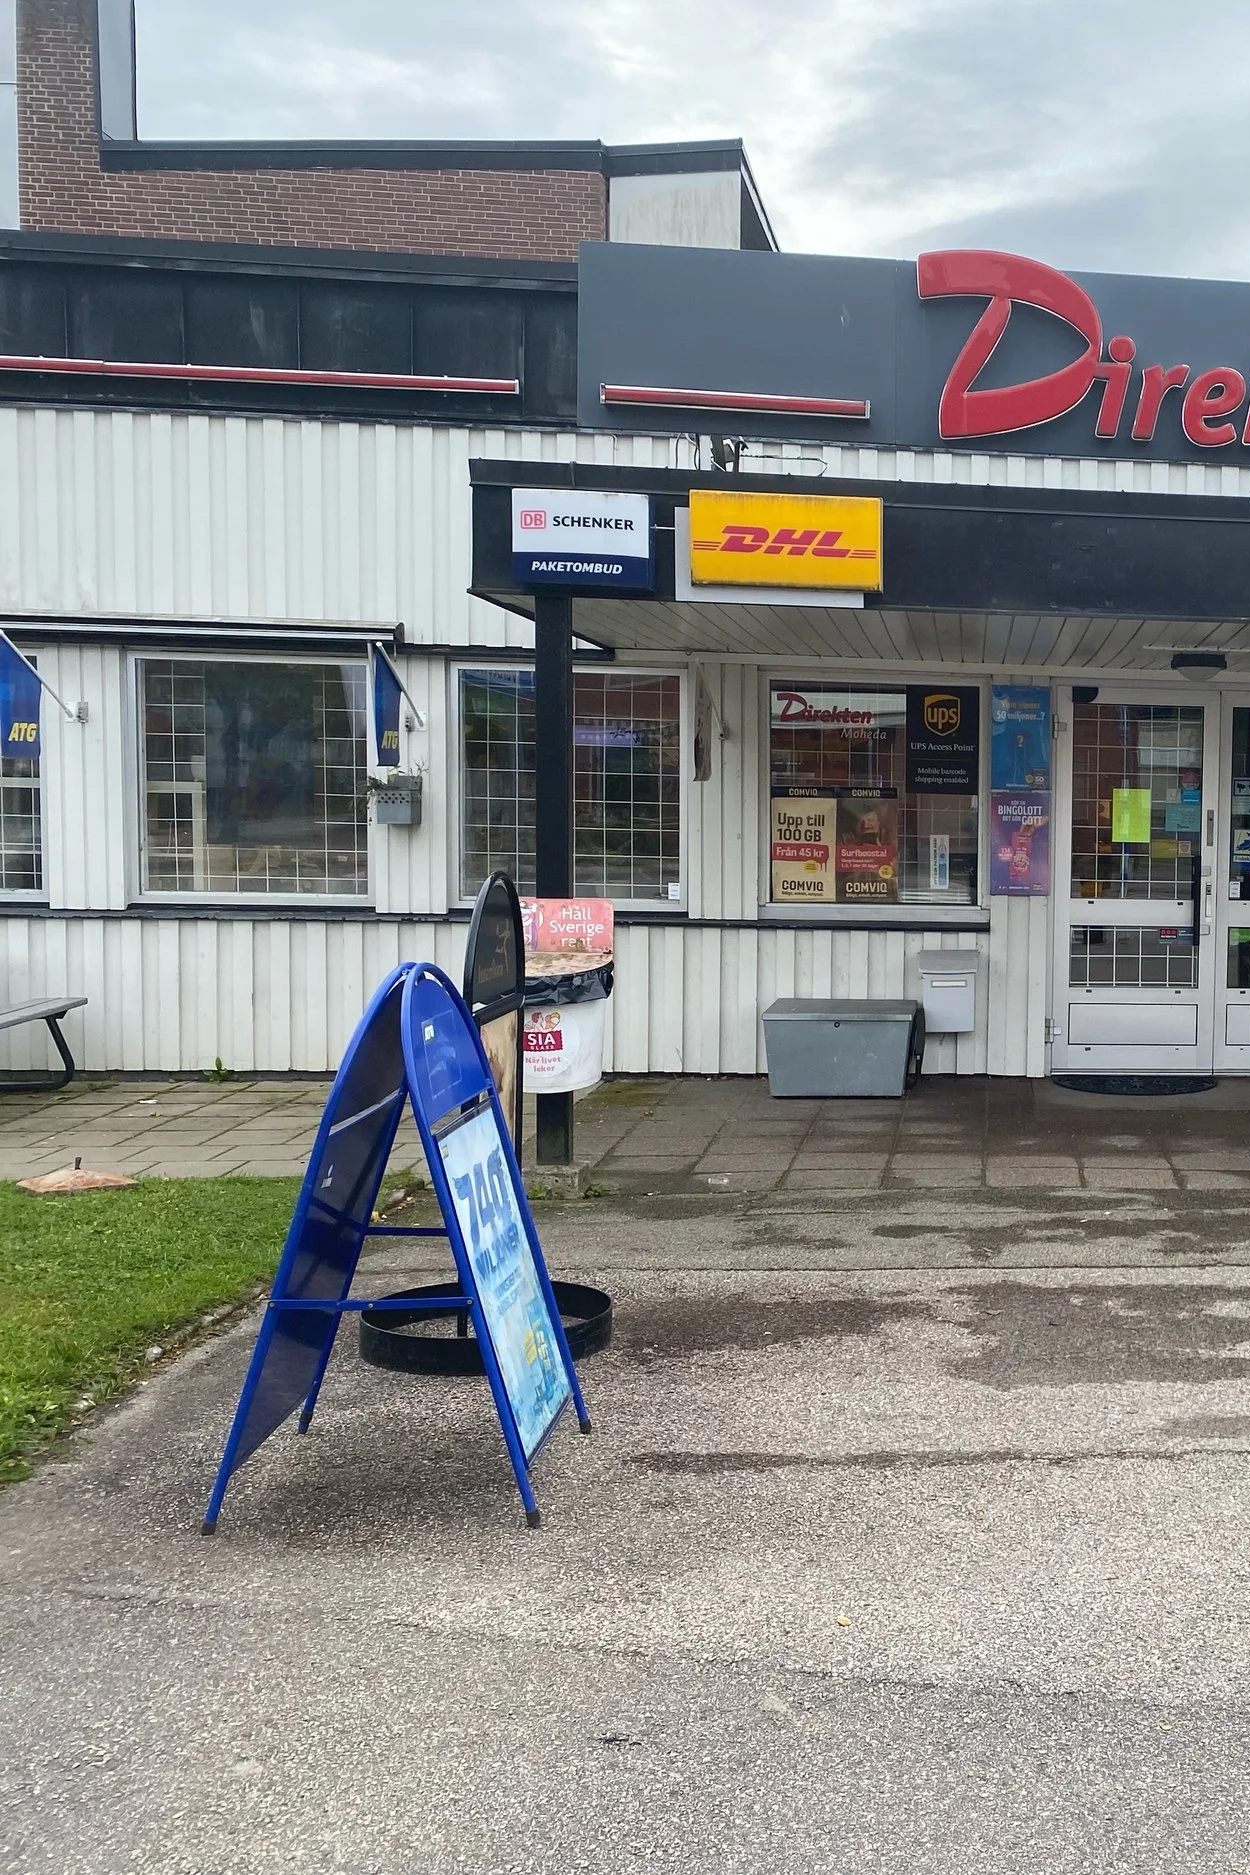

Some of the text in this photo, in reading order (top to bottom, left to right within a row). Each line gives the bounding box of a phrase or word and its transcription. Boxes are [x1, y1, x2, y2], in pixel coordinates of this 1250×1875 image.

[523, 512, 634, 531] DB SCHENKER
[720, 525, 852, 559] DHL
[531, 561, 623, 575] PAKETOMBUD
[777, 693, 872, 724] Direkten
[928, 708, 957, 729] ups
[8, 723, 36, 742] ATG
[841, 728, 887, 740] Moheda
[381, 730, 399, 749] ATG
[928, 743, 952, 751] Access
[954, 744, 974, 752] Point
[915, 776, 943, 784] shipping
[789, 788, 818, 796] COMVIQ
[852, 789, 880, 797] COMVIQ
[998, 806, 1042, 816] BINGOLOTT
[778, 813, 825, 828] Upp till
[1022, 816, 1042, 825] GOTT
[777, 828, 822, 841] 100 GB
[776, 847, 824, 857] Från 45 kr
[841, 849, 887, 857] Surfboosta!
[782, 881, 824, 891] COMVIQ
[846, 882, 888, 893] COMVIQ
[563, 906, 591, 920] Håll
[550, 920, 604, 936] Sverige
[527, 1033, 556, 1046] SIA
[541, 1056, 561, 1065] livet
[534, 1065, 555, 1073] leker
[452, 1146, 513, 1245] 740
